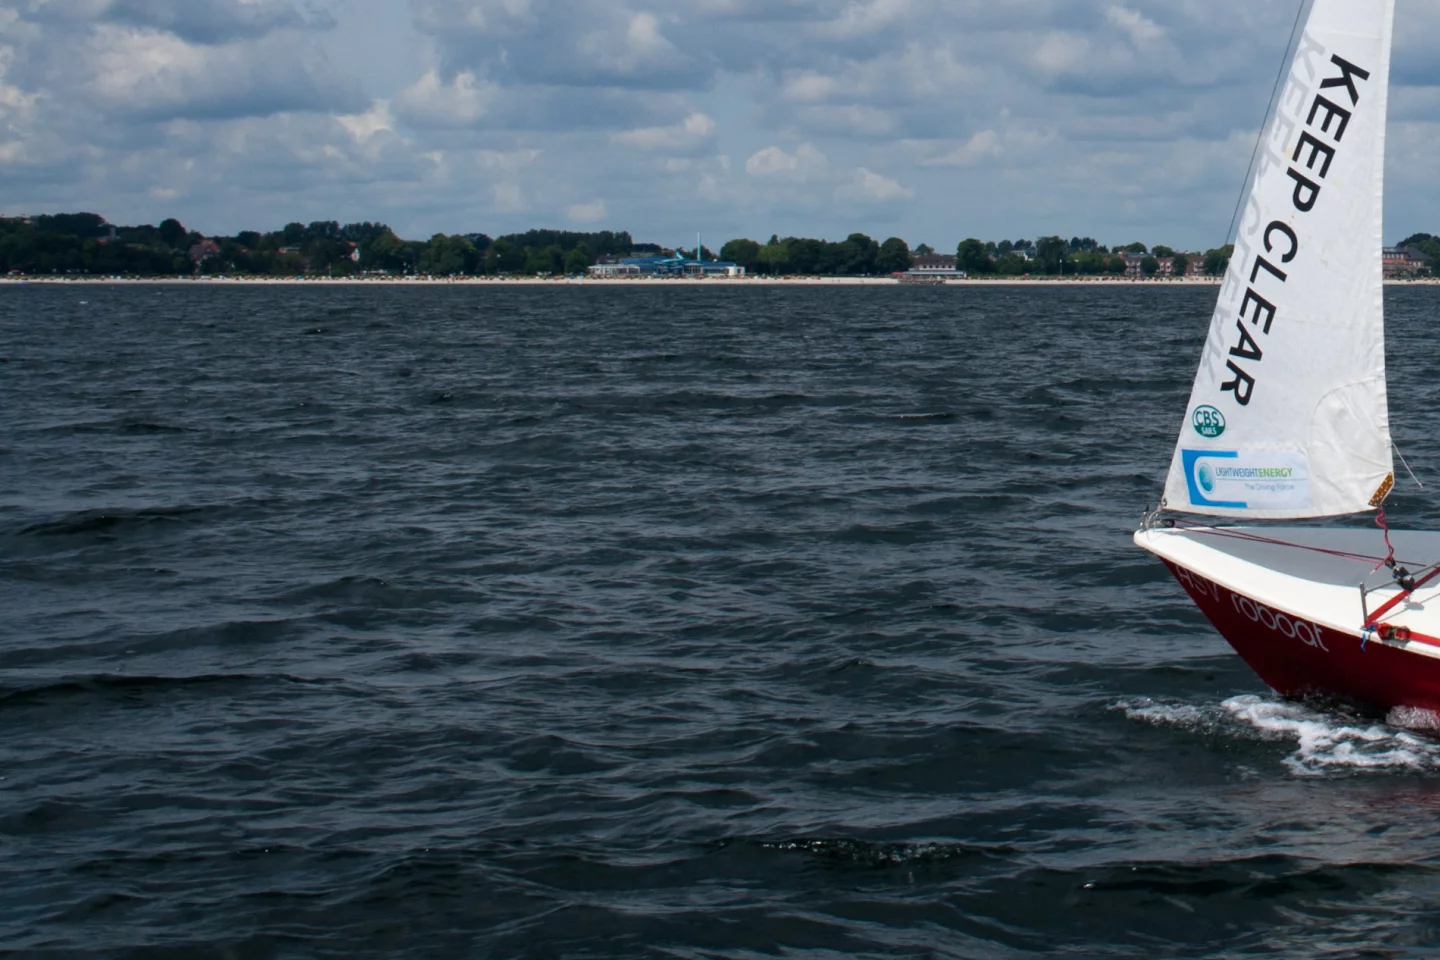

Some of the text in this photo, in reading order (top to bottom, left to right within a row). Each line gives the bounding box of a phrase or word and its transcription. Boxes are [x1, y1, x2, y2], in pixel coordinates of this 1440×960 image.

[1220, 53, 1370, 407] KEEP CLEAR
[1195, 410, 1220, 427] CBS
